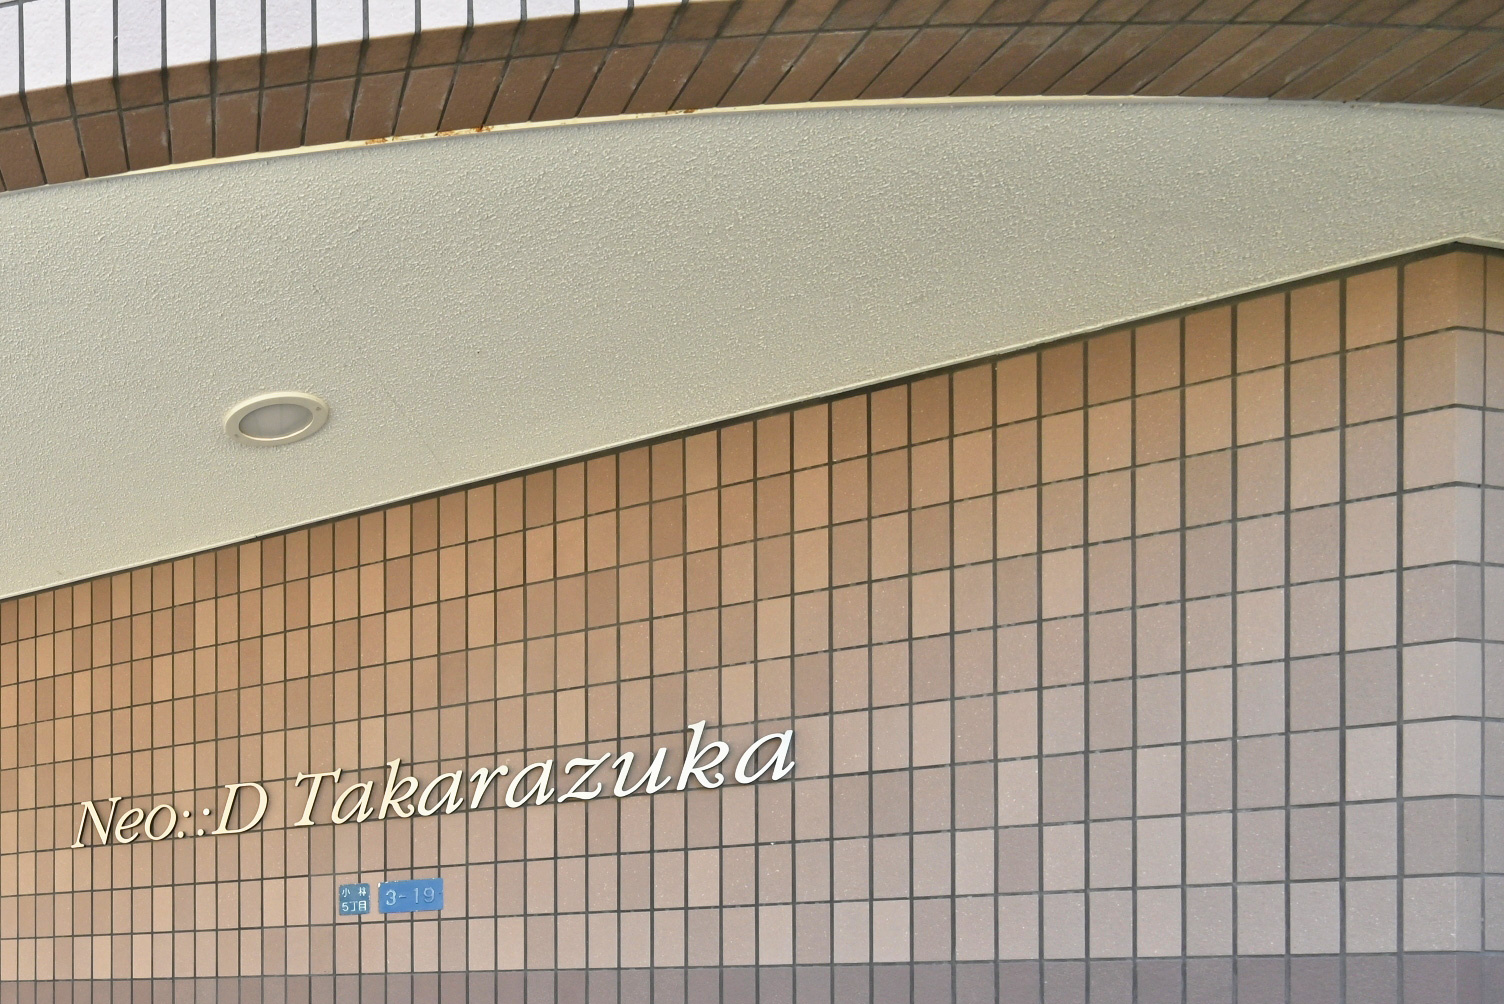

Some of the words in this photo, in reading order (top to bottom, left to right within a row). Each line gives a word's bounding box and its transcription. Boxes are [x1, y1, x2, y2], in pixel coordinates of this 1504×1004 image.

[71, 782, 269, 850] Neo::D
[294, 720, 797, 828] Takarazuka
[341, 900, 367, 912] 5丁目
[385, 887, 435, 906] 3-19
